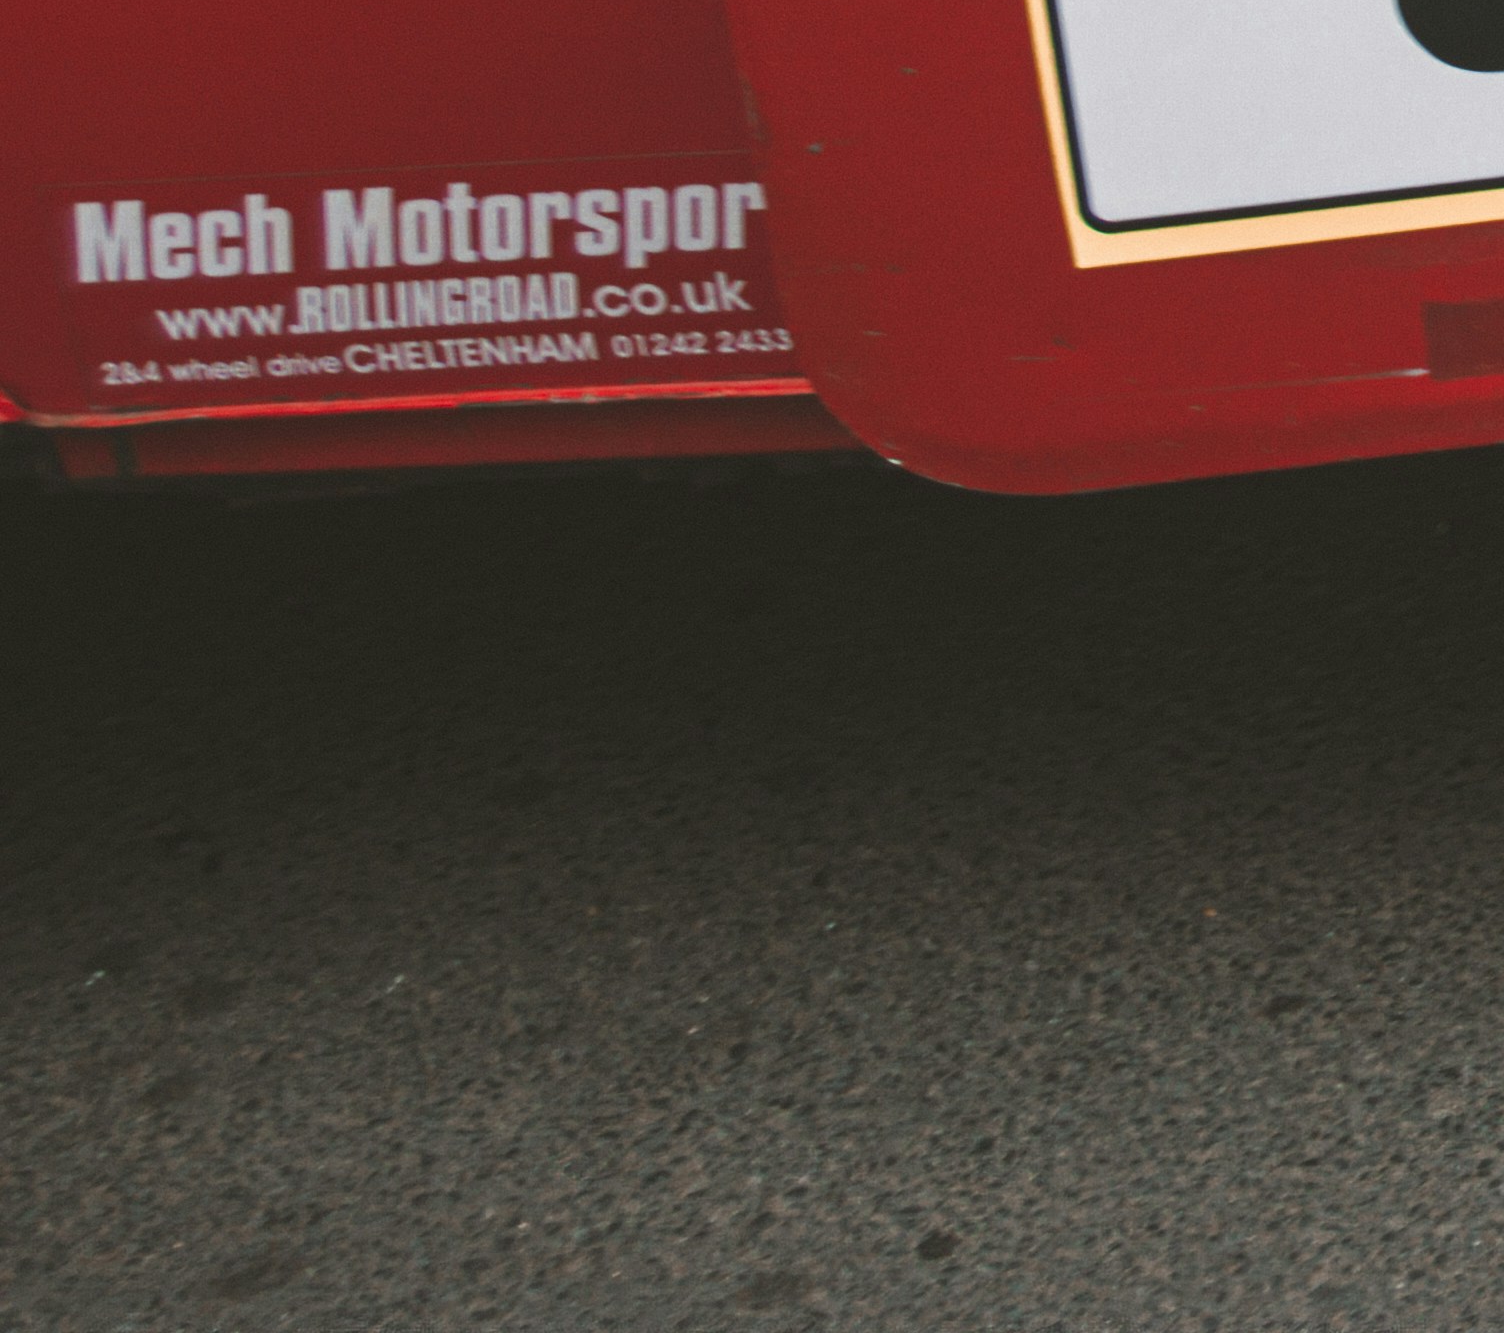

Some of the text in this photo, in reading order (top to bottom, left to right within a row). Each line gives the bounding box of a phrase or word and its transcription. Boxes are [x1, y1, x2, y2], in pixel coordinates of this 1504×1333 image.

[72, 181, 768, 285] Mech Motorspor
[154, 270, 755, 343] www.ROLLINGROAD.co.uk
[99, 359, 163, 386] 2&4
[167, 355, 262, 383] wheel
[265, 351, 343, 378] drive
[343, 331, 601, 376] CHELTENHAM
[609, 331, 711, 359] 01242
